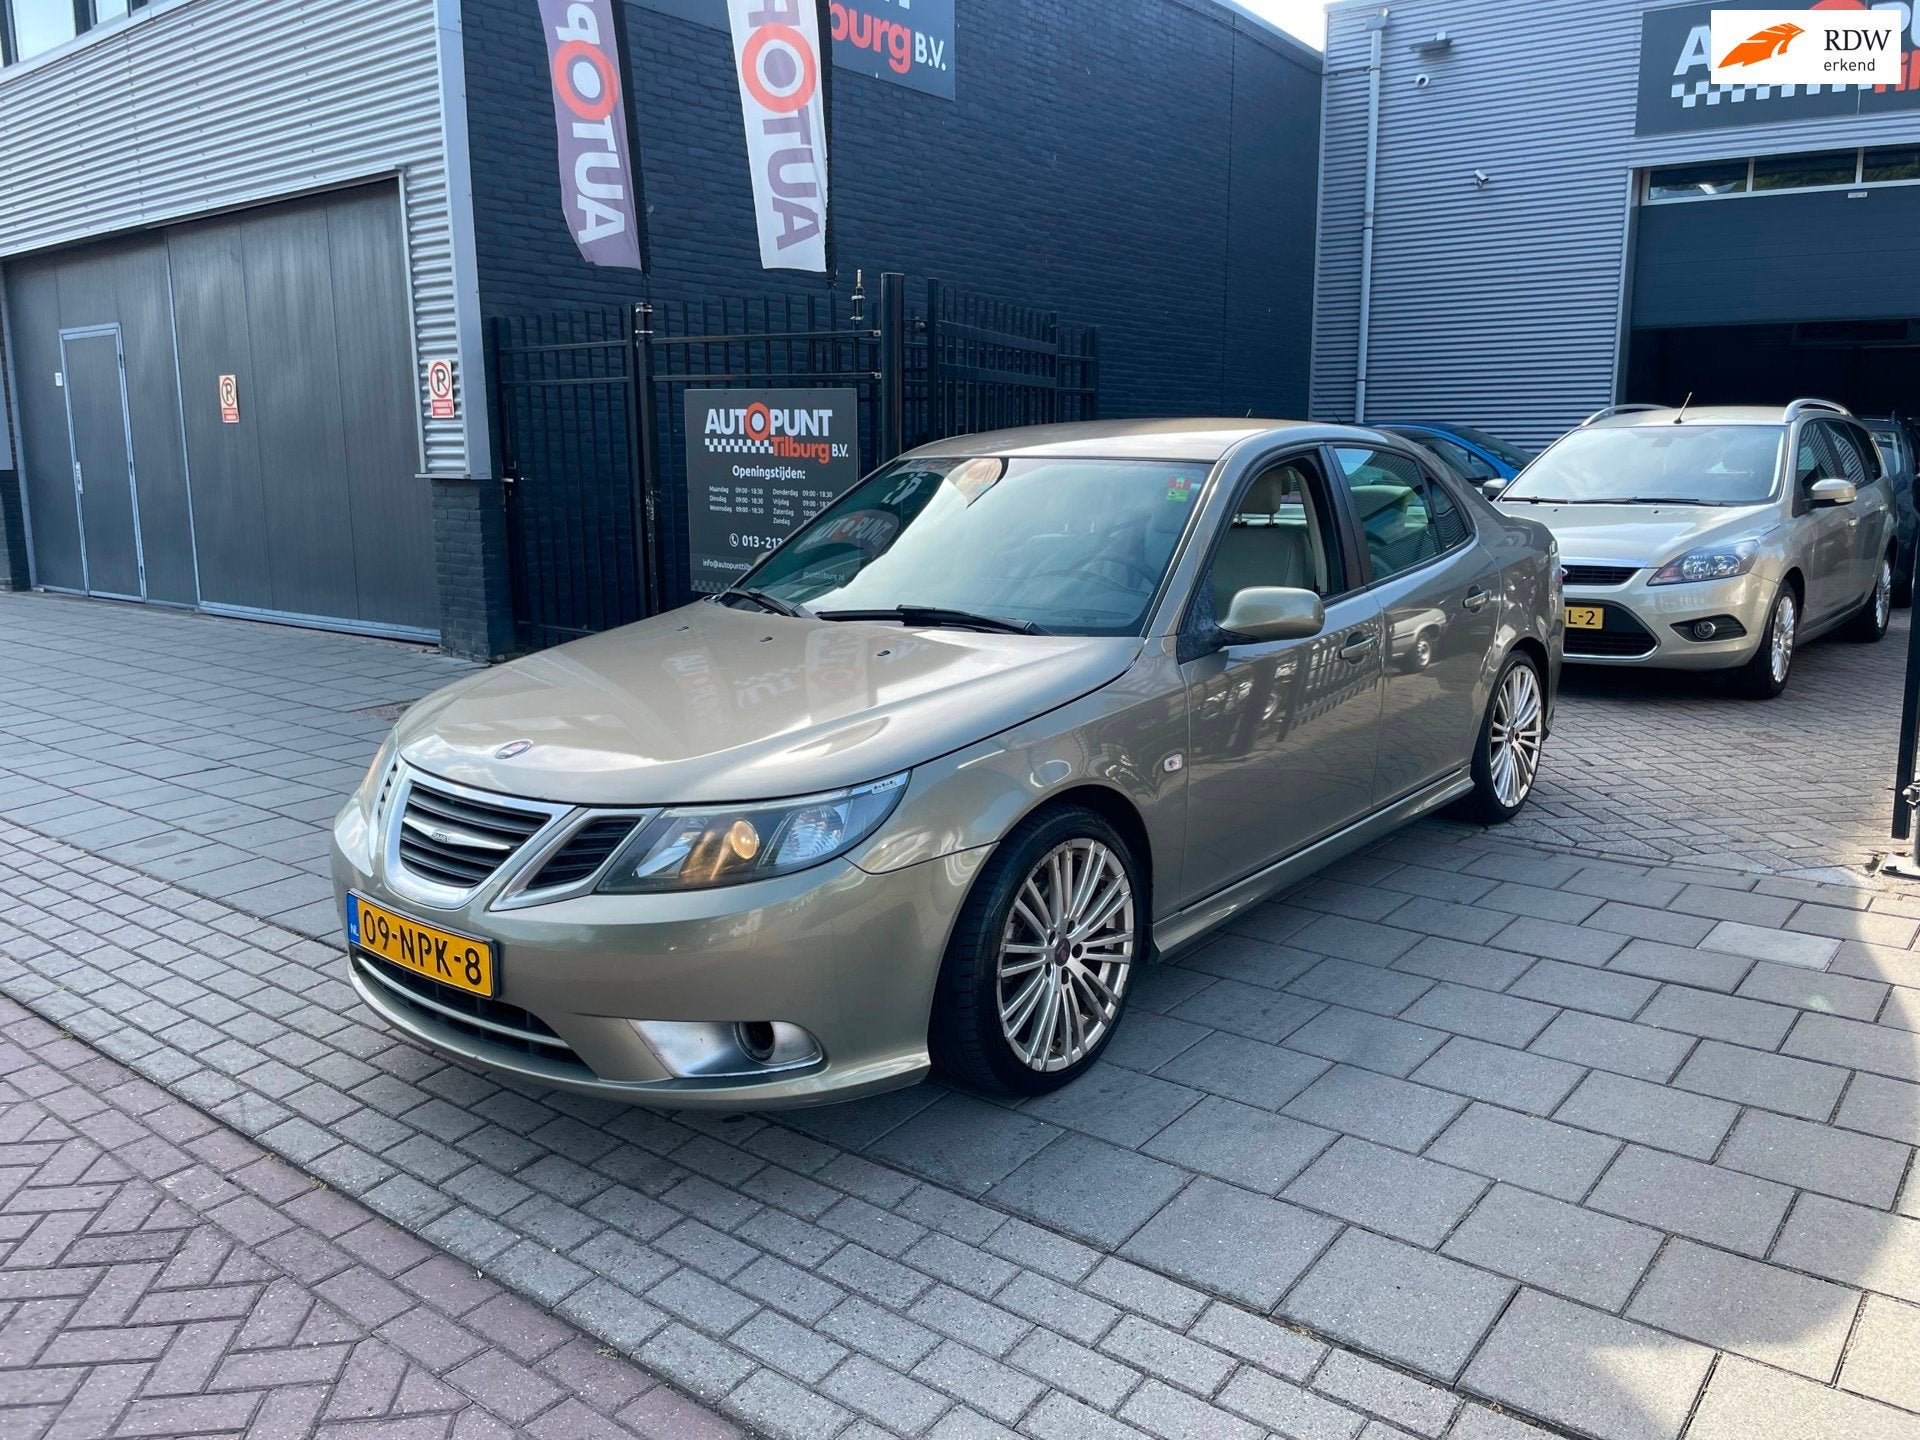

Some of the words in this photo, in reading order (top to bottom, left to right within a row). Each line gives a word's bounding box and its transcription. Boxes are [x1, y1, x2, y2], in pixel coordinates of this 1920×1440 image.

[914, 31, 947, 71] B.V.
[704, 402, 833, 441] AUTOPUNT
[770, 436, 830, 464] Tilburg
[832, 443, 849, 458] B.V.
[732, 465, 806, 480] Openingstijden:
[742, 534, 760, 548] 013
[1565, 609, 1596, 625] L-2
[363, 909, 482, 986] 09-NPK-8
